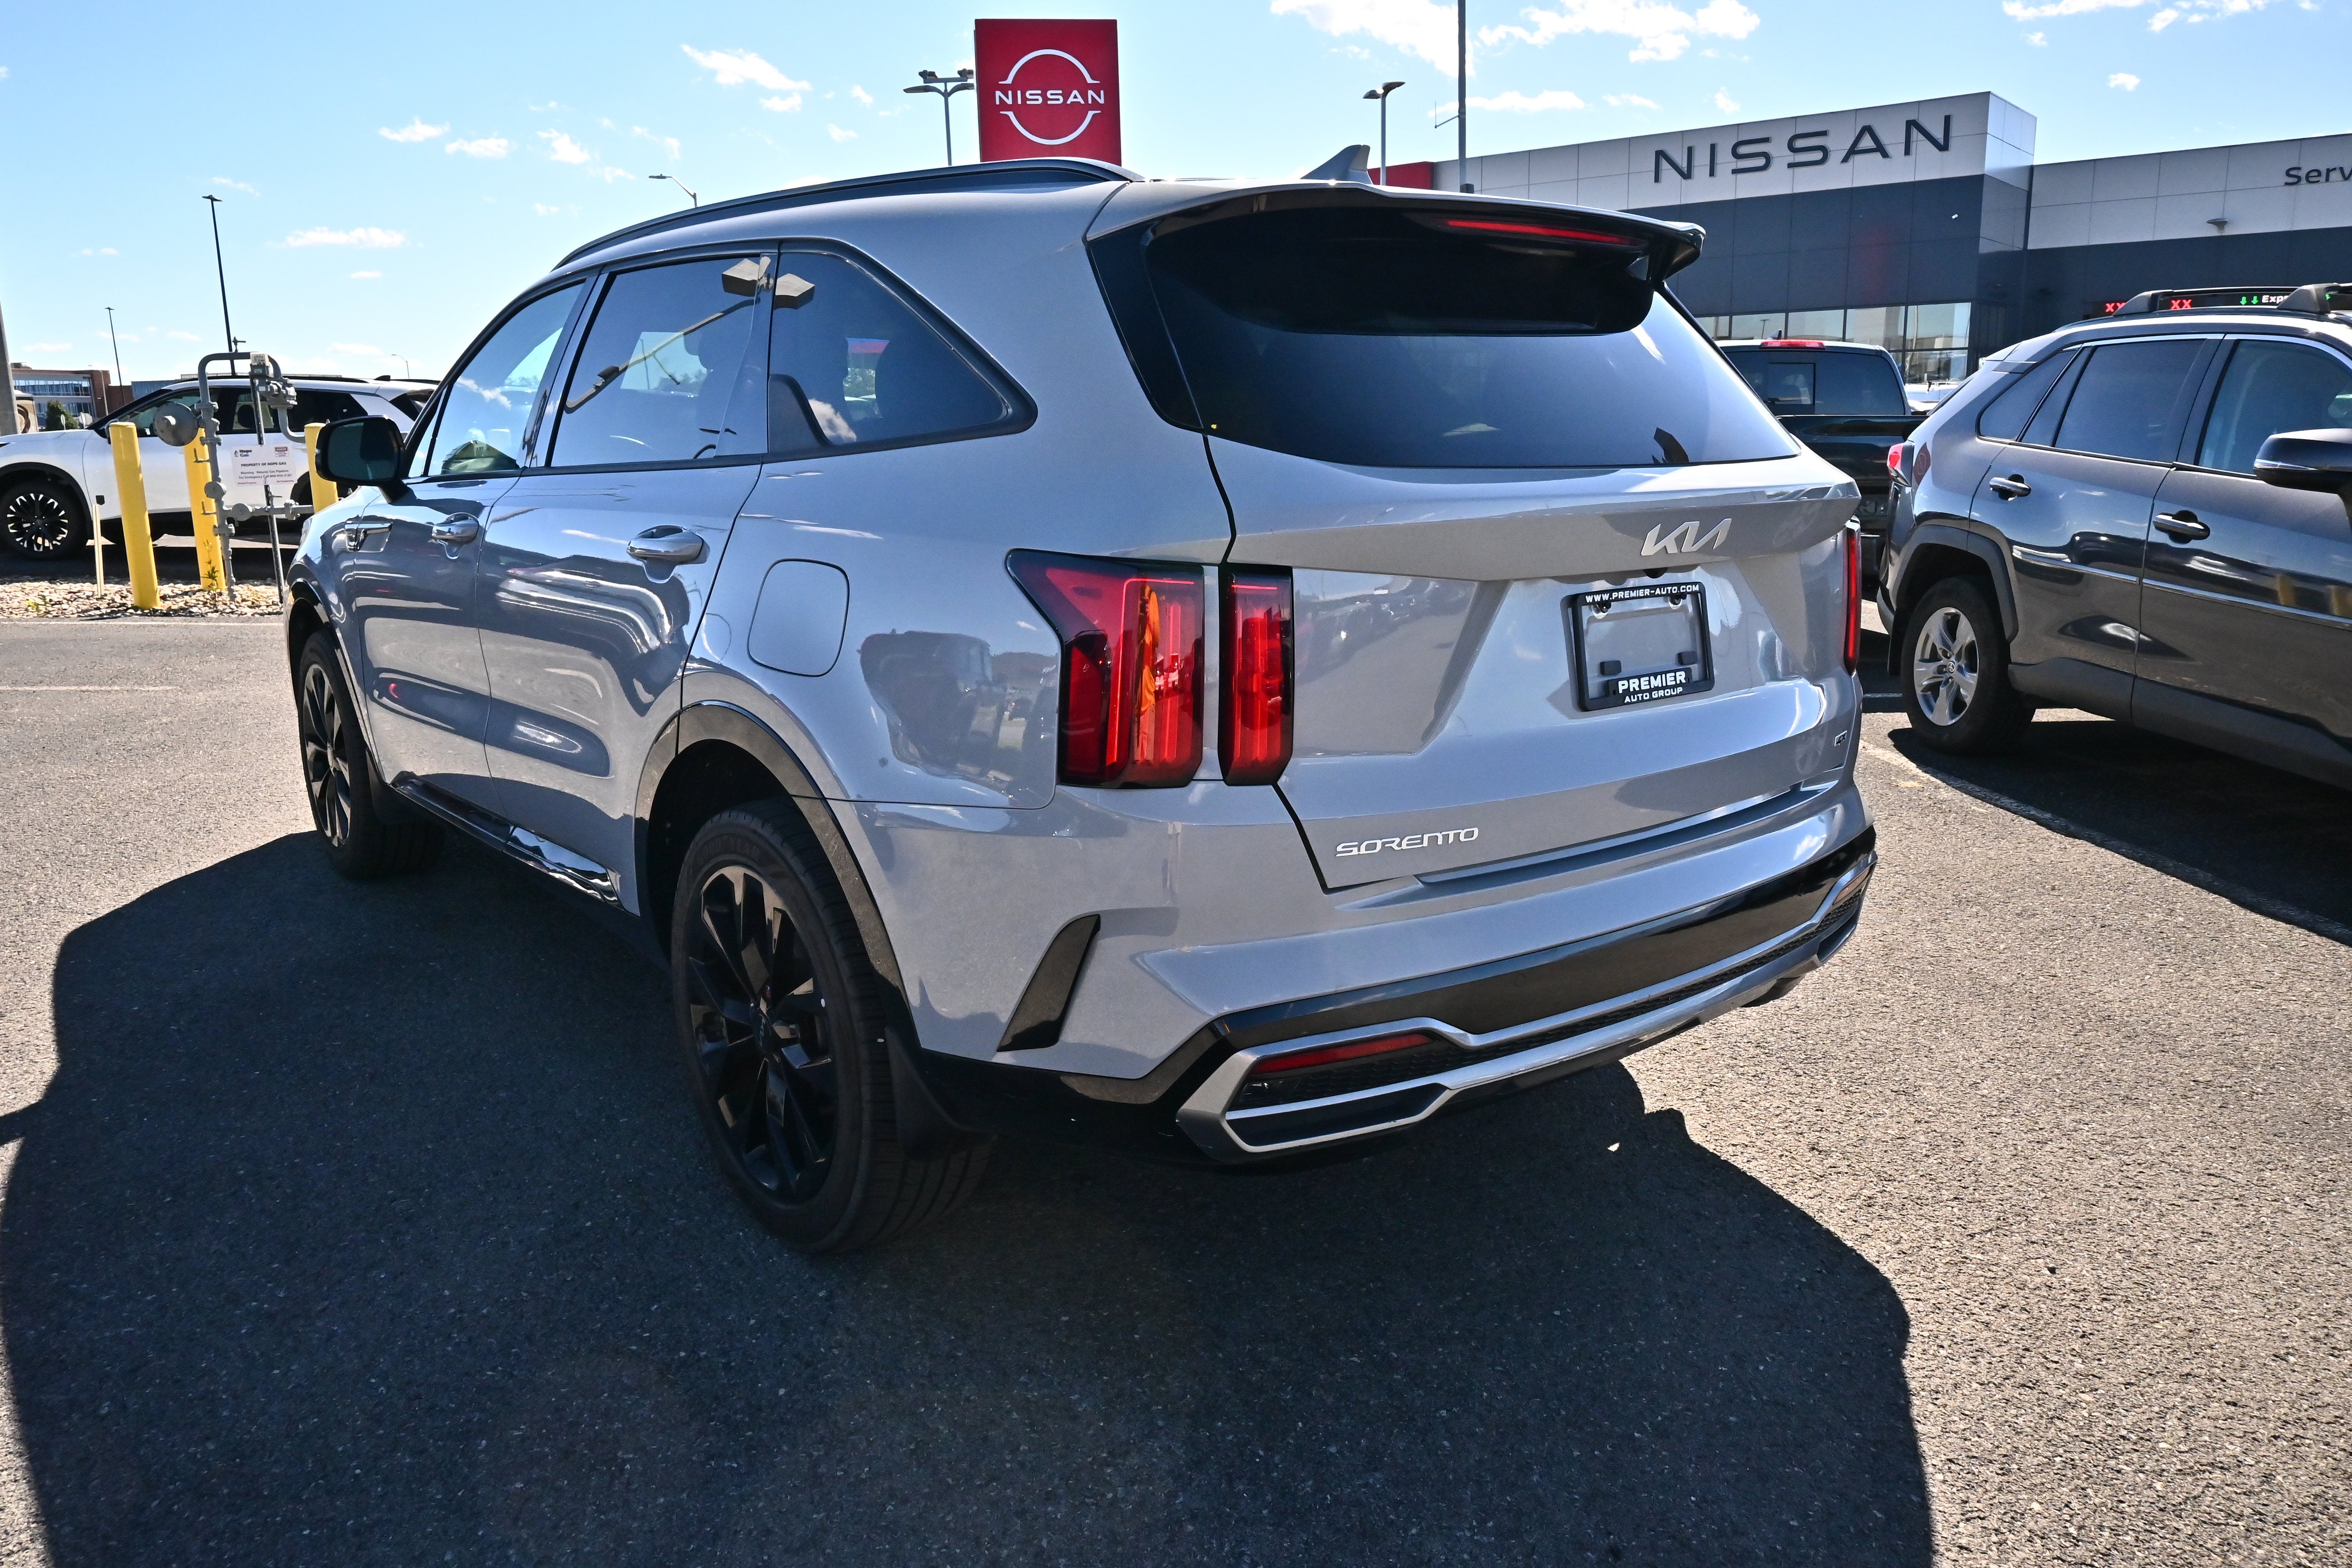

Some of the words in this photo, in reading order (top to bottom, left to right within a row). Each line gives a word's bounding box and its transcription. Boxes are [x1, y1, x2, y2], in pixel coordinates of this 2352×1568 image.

[995, 90, 1105, 105] NISSAN
[1654, 114, 1952, 183] NISSAN
[2284, 166, 2352, 185] Serv
[2170, 299, 2192, 309] XX
[1641, 518, 1732, 556] KIA
[1585, 584, 1699, 603] WWW.PREMIER-AUTO.COM
[1618, 670, 1686, 694] PREMIER
[1624, 692, 1650, 703] AUTO
[1652, 686, 1683, 699] GROUP
[1335, 827, 1478, 857] SORENTO
